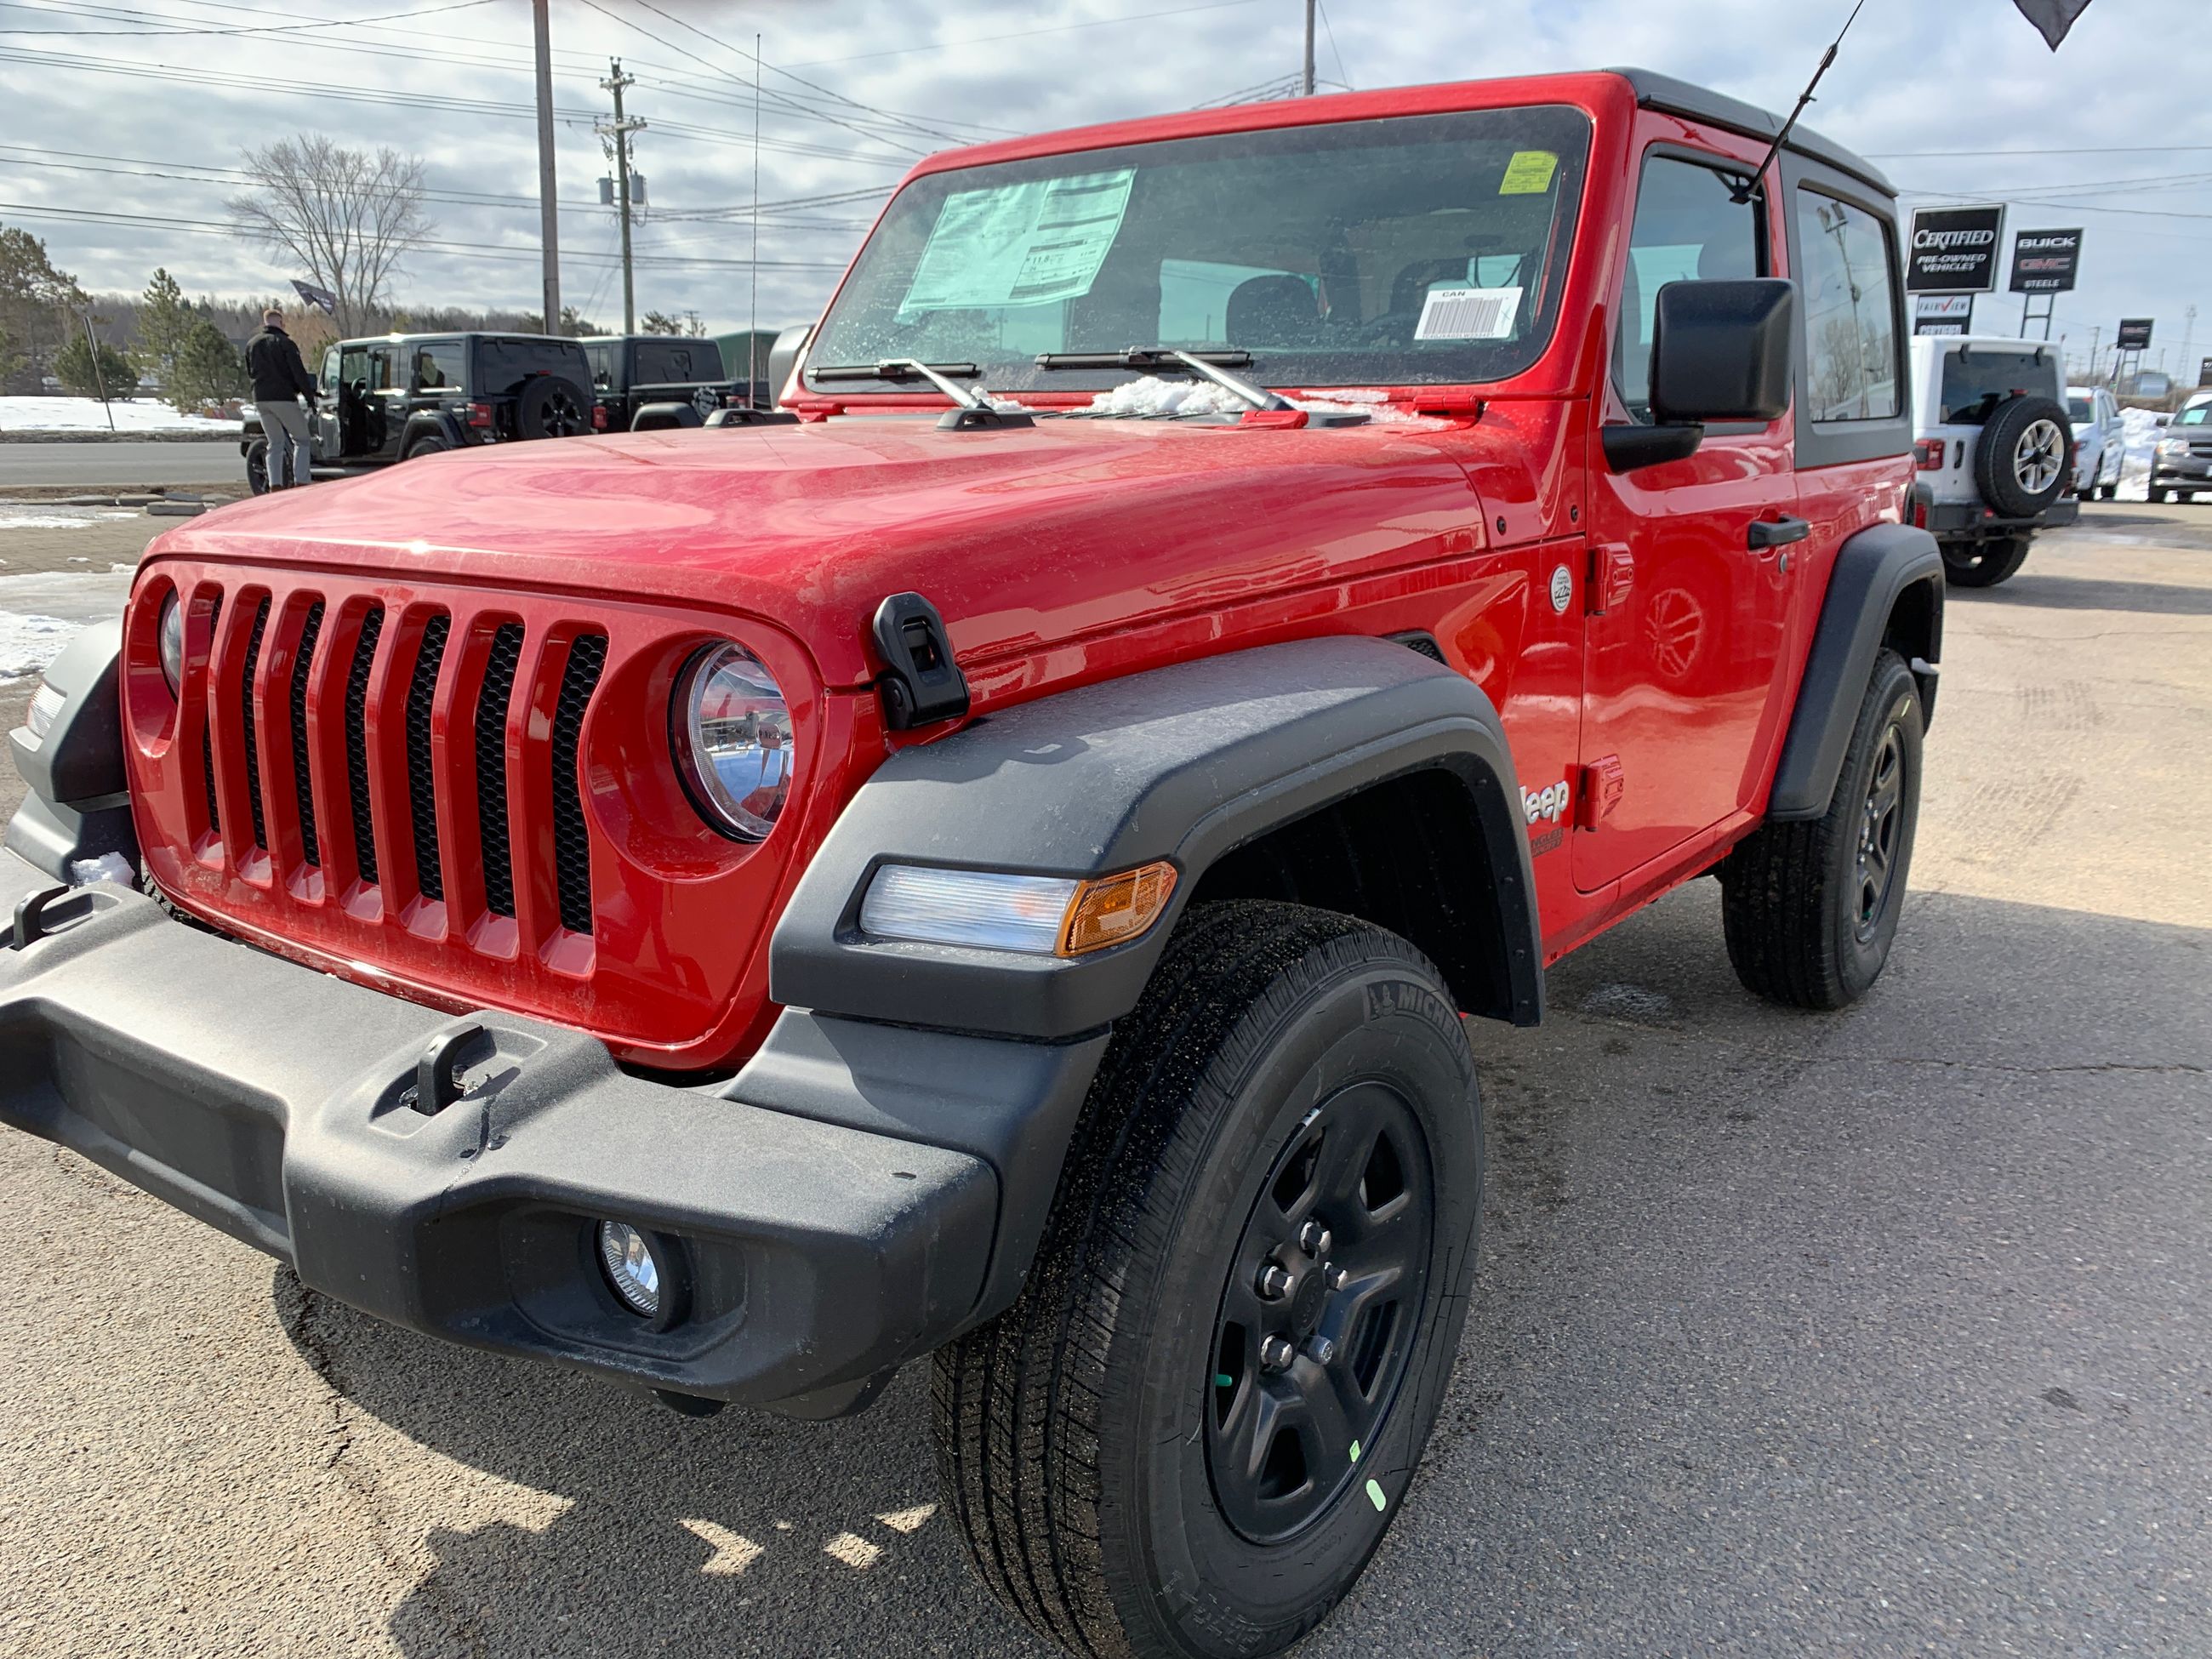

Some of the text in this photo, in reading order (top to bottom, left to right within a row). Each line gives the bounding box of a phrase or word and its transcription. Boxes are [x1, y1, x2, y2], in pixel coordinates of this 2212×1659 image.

[1913, 229, 1994, 250] CERTIFIED
[2018, 237, 2076, 249] BUICK
[1916, 254, 1987, 265] PRE-OWNED
[2020, 257, 2071, 271] GMC
[1921, 262, 1976, 273] VEHICLES
[2024, 278, 2060, 289] STEELE
